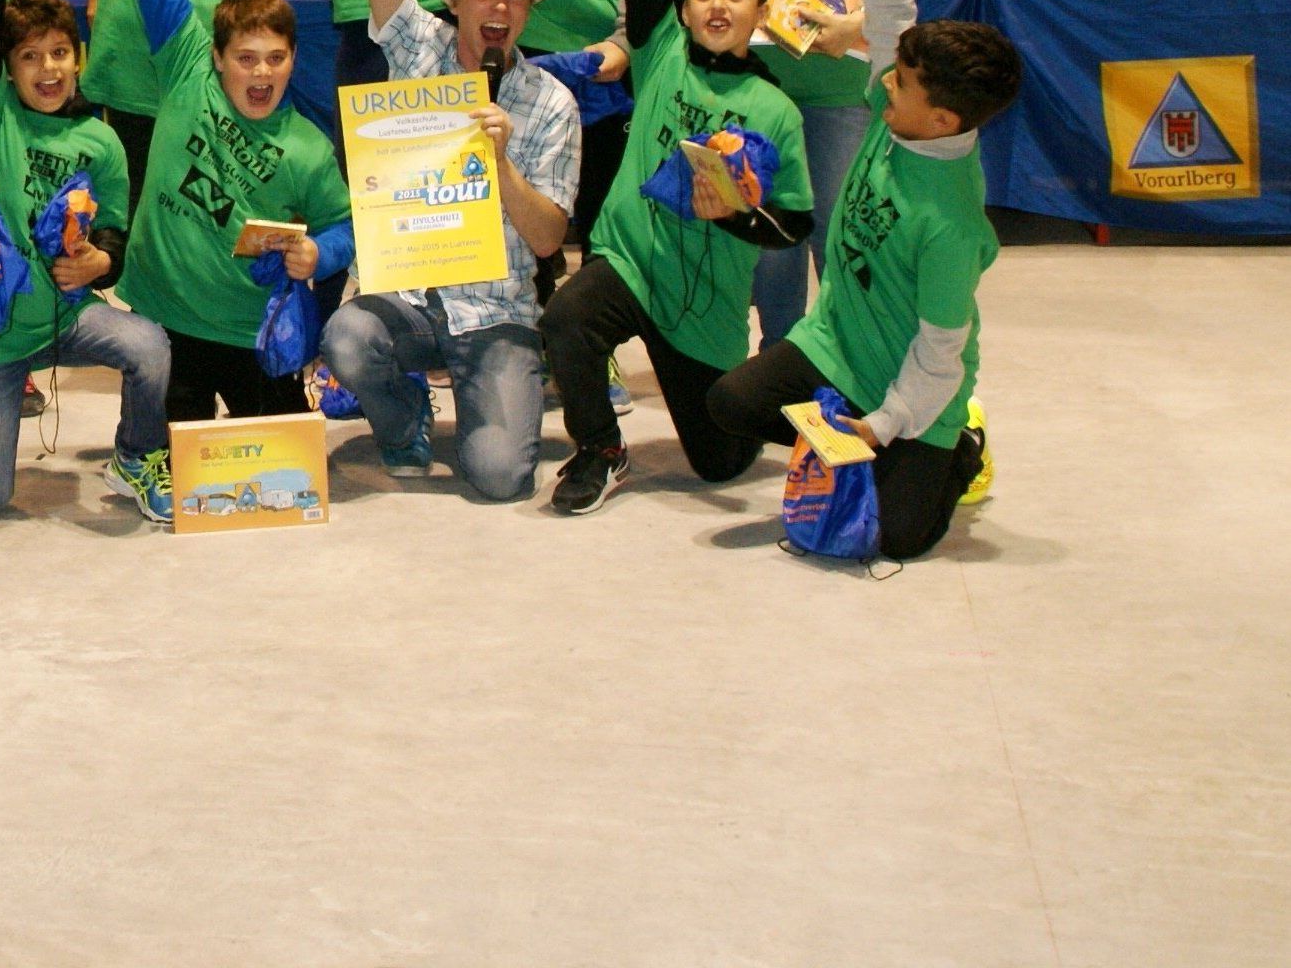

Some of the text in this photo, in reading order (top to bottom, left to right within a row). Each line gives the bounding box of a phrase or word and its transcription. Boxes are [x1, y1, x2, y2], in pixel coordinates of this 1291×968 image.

[351, 81, 478, 115] URKUNDE
[1134, 170, 1236, 189] Vorarlberg
[397, 180, 489, 205] 2015 tour
[412, 212, 460, 225] ZIVILSCHUTZ
[199, 443, 264, 461] SAFETY
